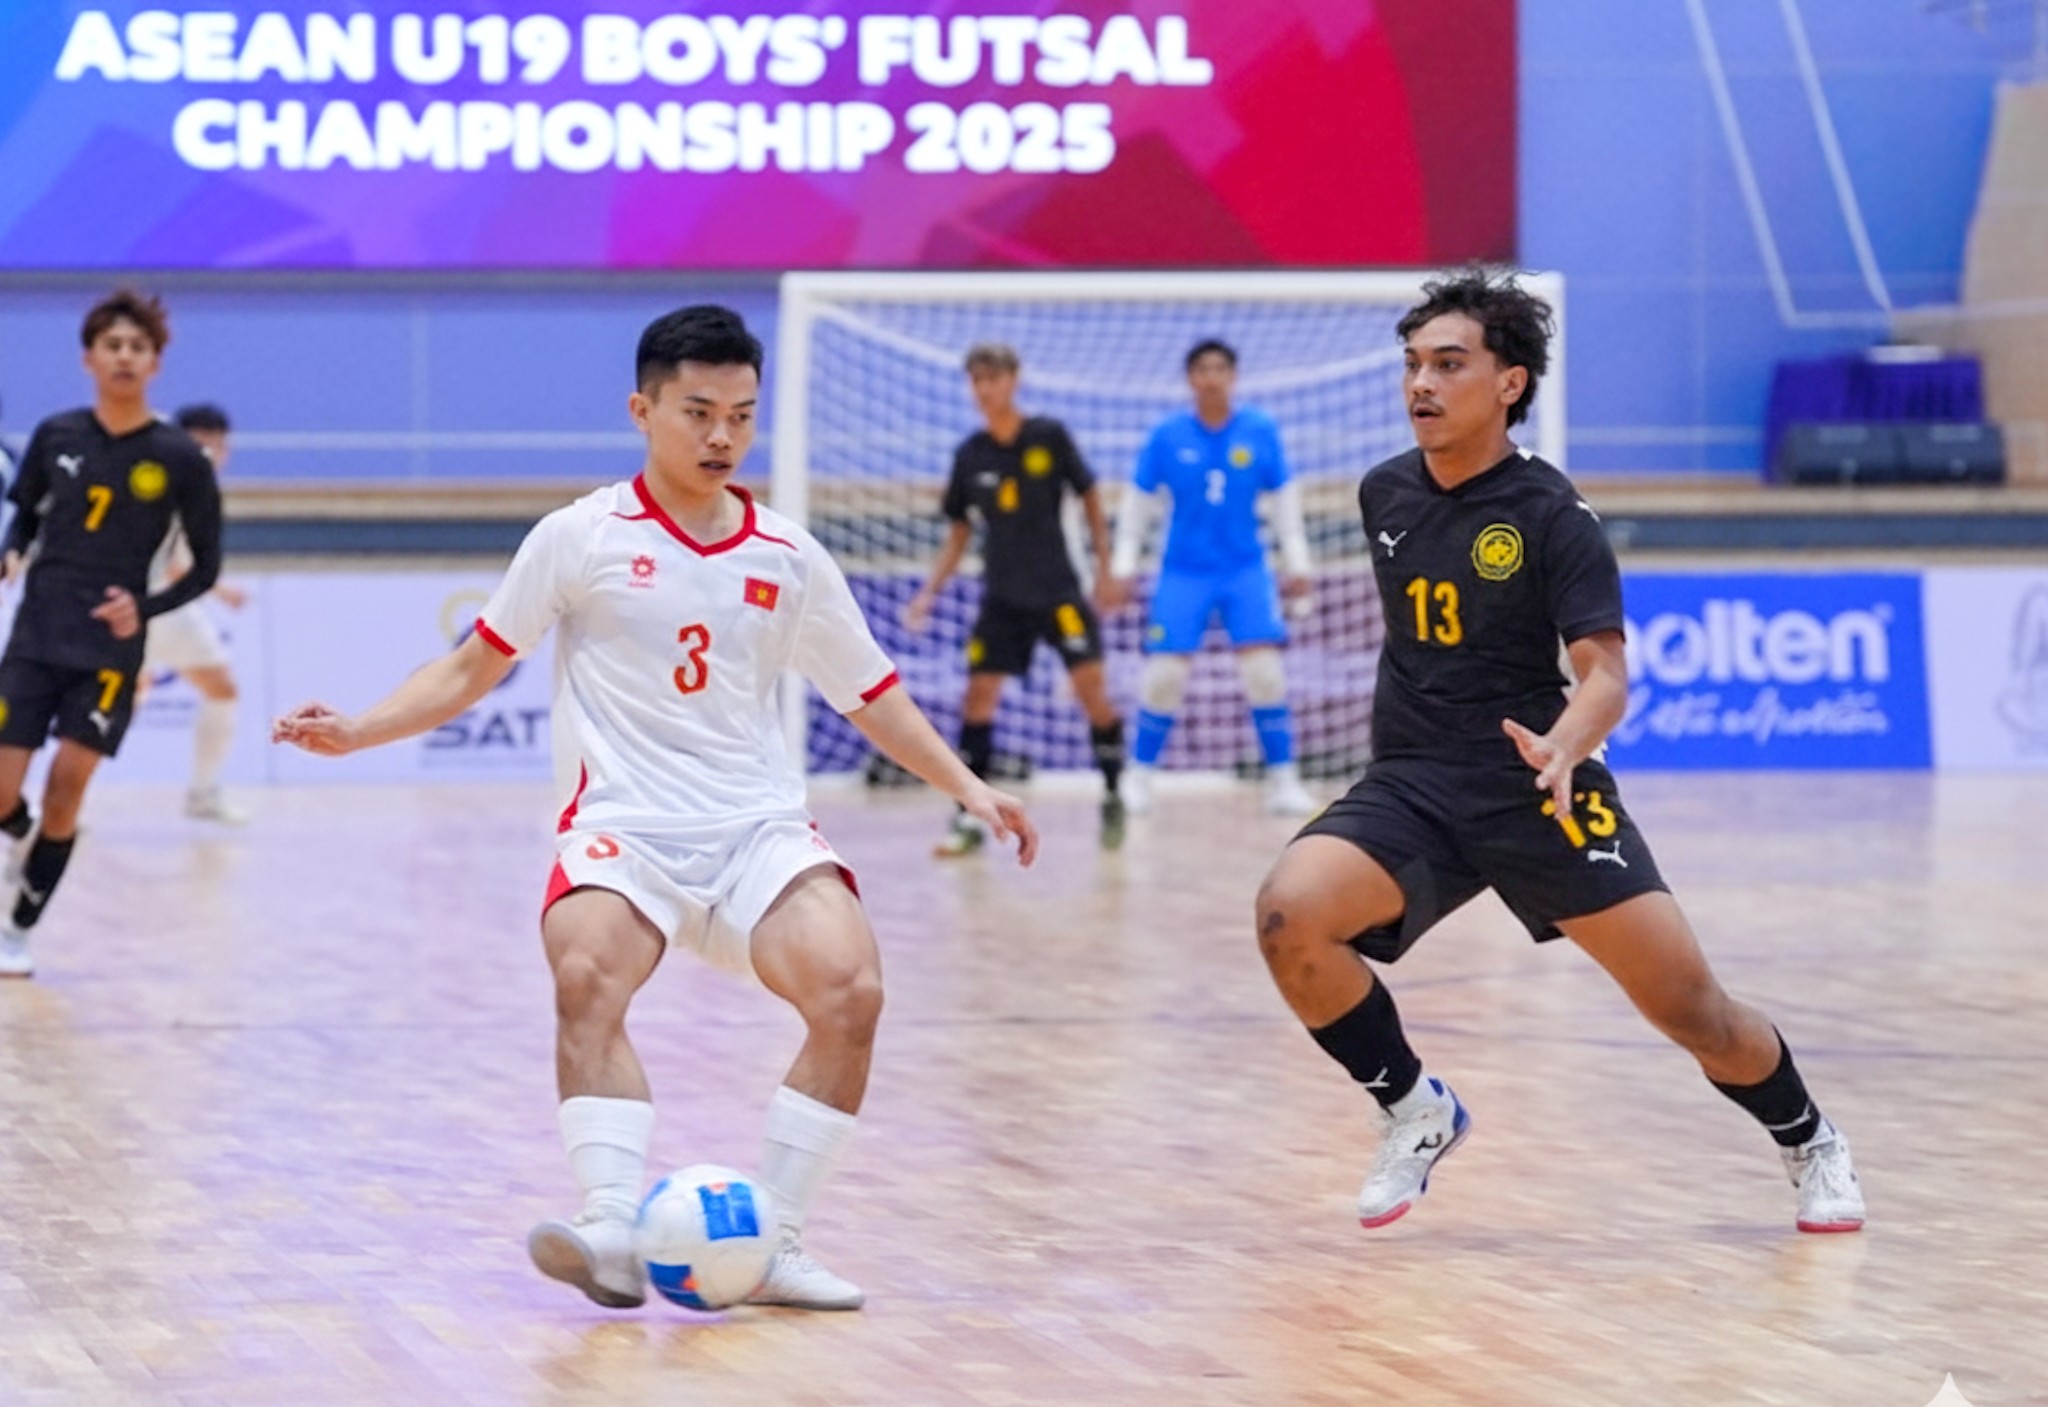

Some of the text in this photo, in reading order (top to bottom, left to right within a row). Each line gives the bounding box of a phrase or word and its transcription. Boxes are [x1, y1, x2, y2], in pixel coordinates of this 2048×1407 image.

[55, 10, 1213, 87] ASEAN U19 BOYS' FUTSAL
[172, 98, 1115, 173] CHAMPIONSHIP 2025
[85, 485, 113, 531] 7
[1405, 576, 1463, 646] 13
[98, 669, 123, 712] 7
[673, 623, 712, 695] 3
